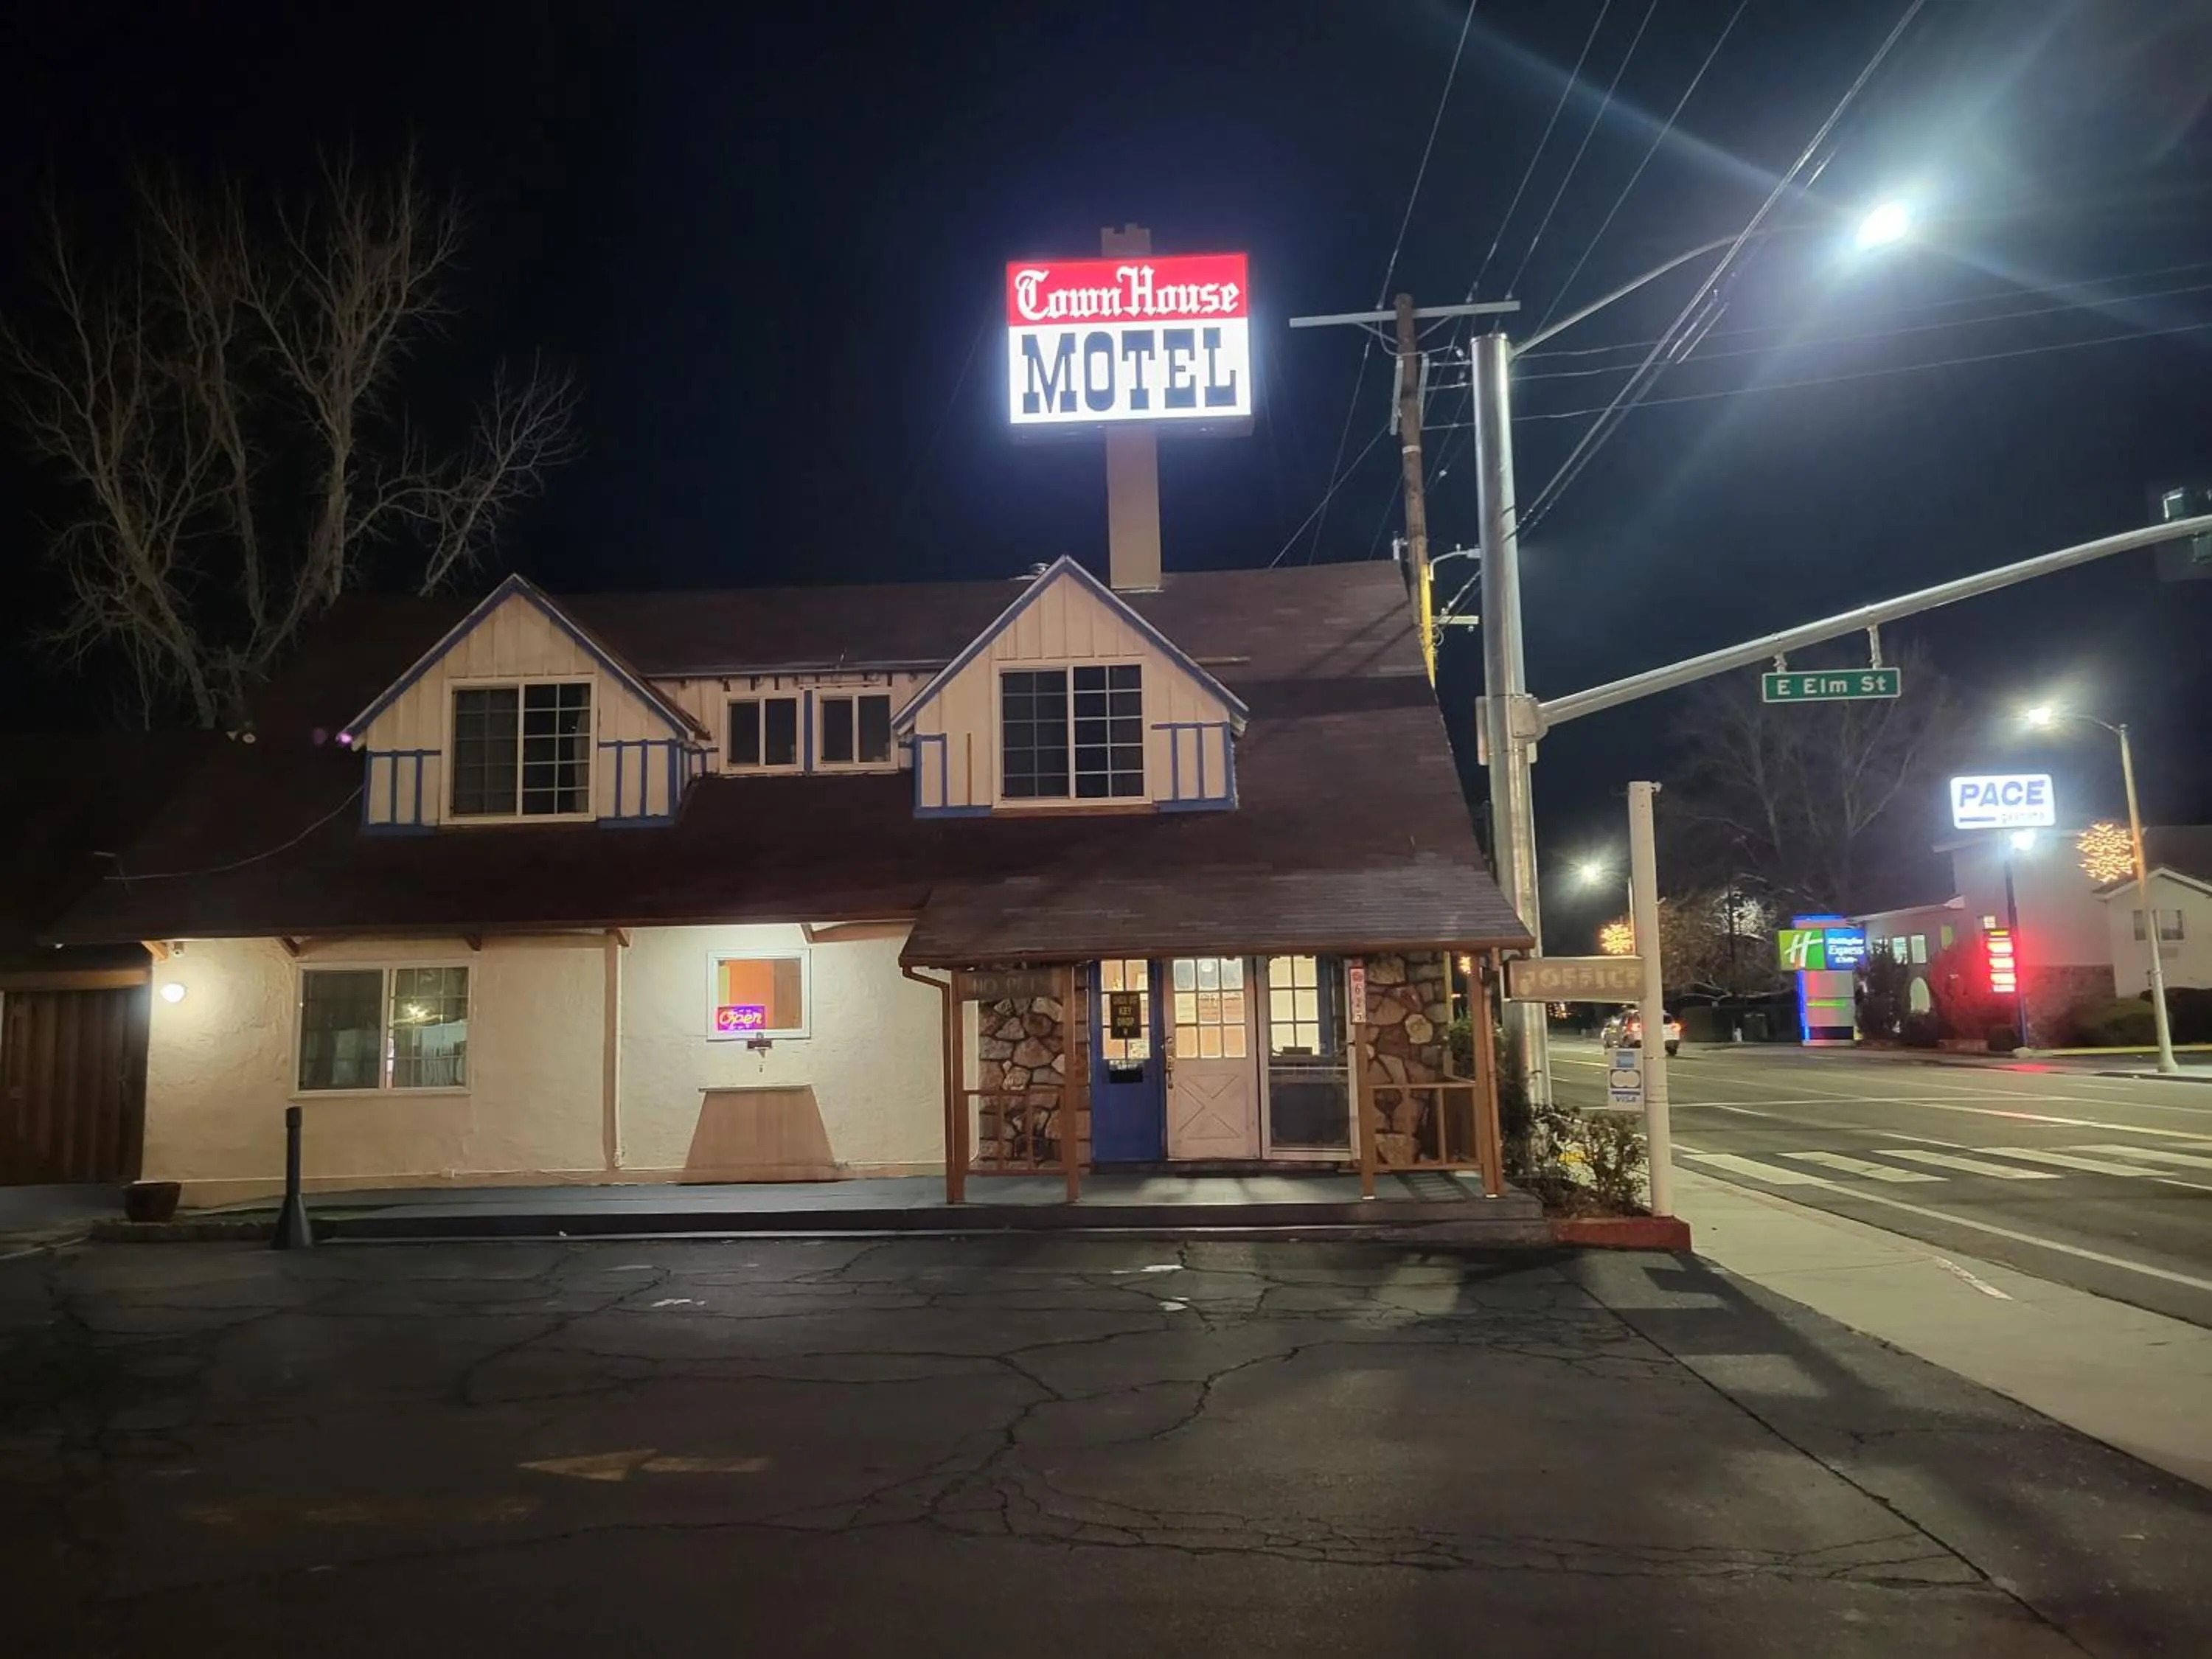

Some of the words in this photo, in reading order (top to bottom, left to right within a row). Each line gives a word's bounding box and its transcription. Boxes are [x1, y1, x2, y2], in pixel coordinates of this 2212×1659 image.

[1021, 327, 1237, 414] MOTEL
[1776, 679, 1790, 695] E
[1803, 678, 1848, 695] Elm
[1860, 675, 1887, 692] St
[1958, 779, 2045, 808] PACE
[719, 1011, 762, 1030] Open
